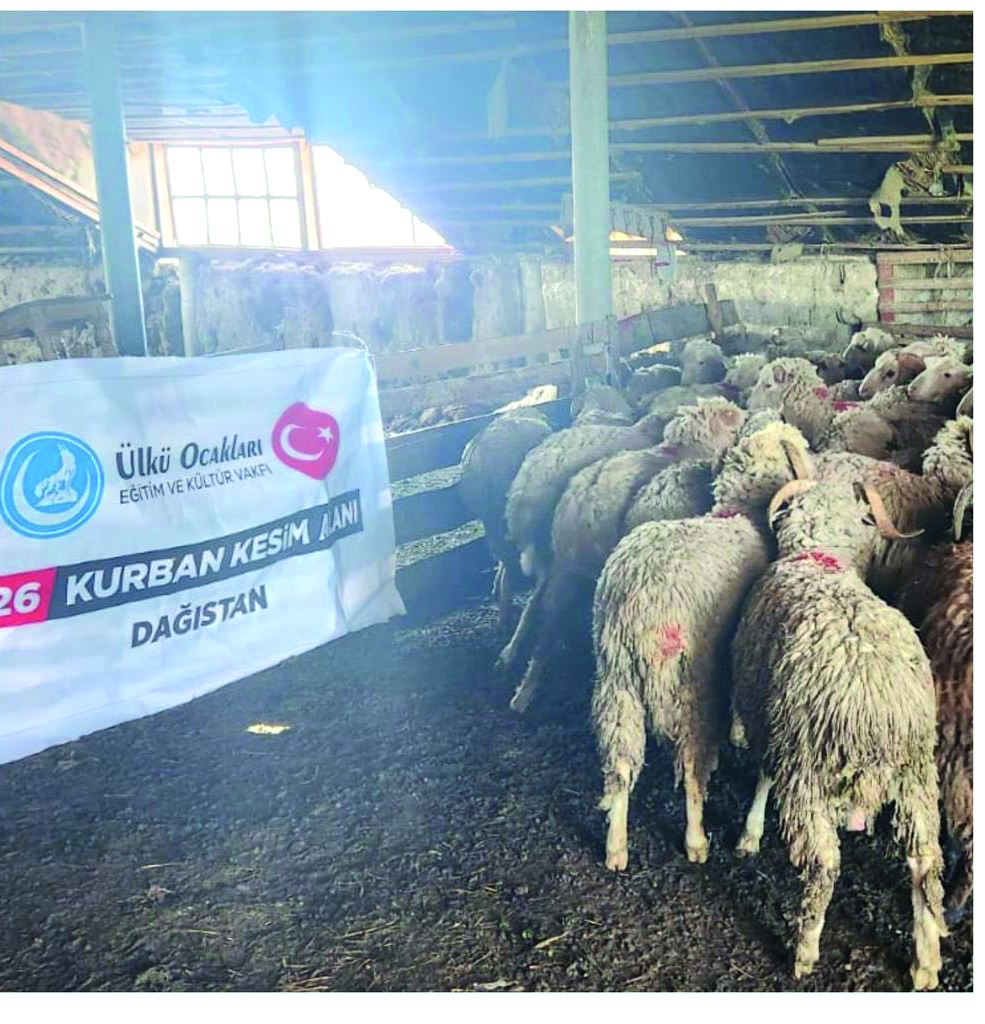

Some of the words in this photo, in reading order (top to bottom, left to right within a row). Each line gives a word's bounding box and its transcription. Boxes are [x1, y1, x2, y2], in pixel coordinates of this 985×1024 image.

[116, 442, 171, 480] Ülkü
[120, 480, 165, 505] EĞİTİM
[166, 479, 185, 496] VE
[187, 470, 234, 491] KÜLTÜR
[234, 463, 273, 482] VAKFI
[66, 545, 226, 606] KURBAN
[131, 584, 269, 649] DAĞISTAN
